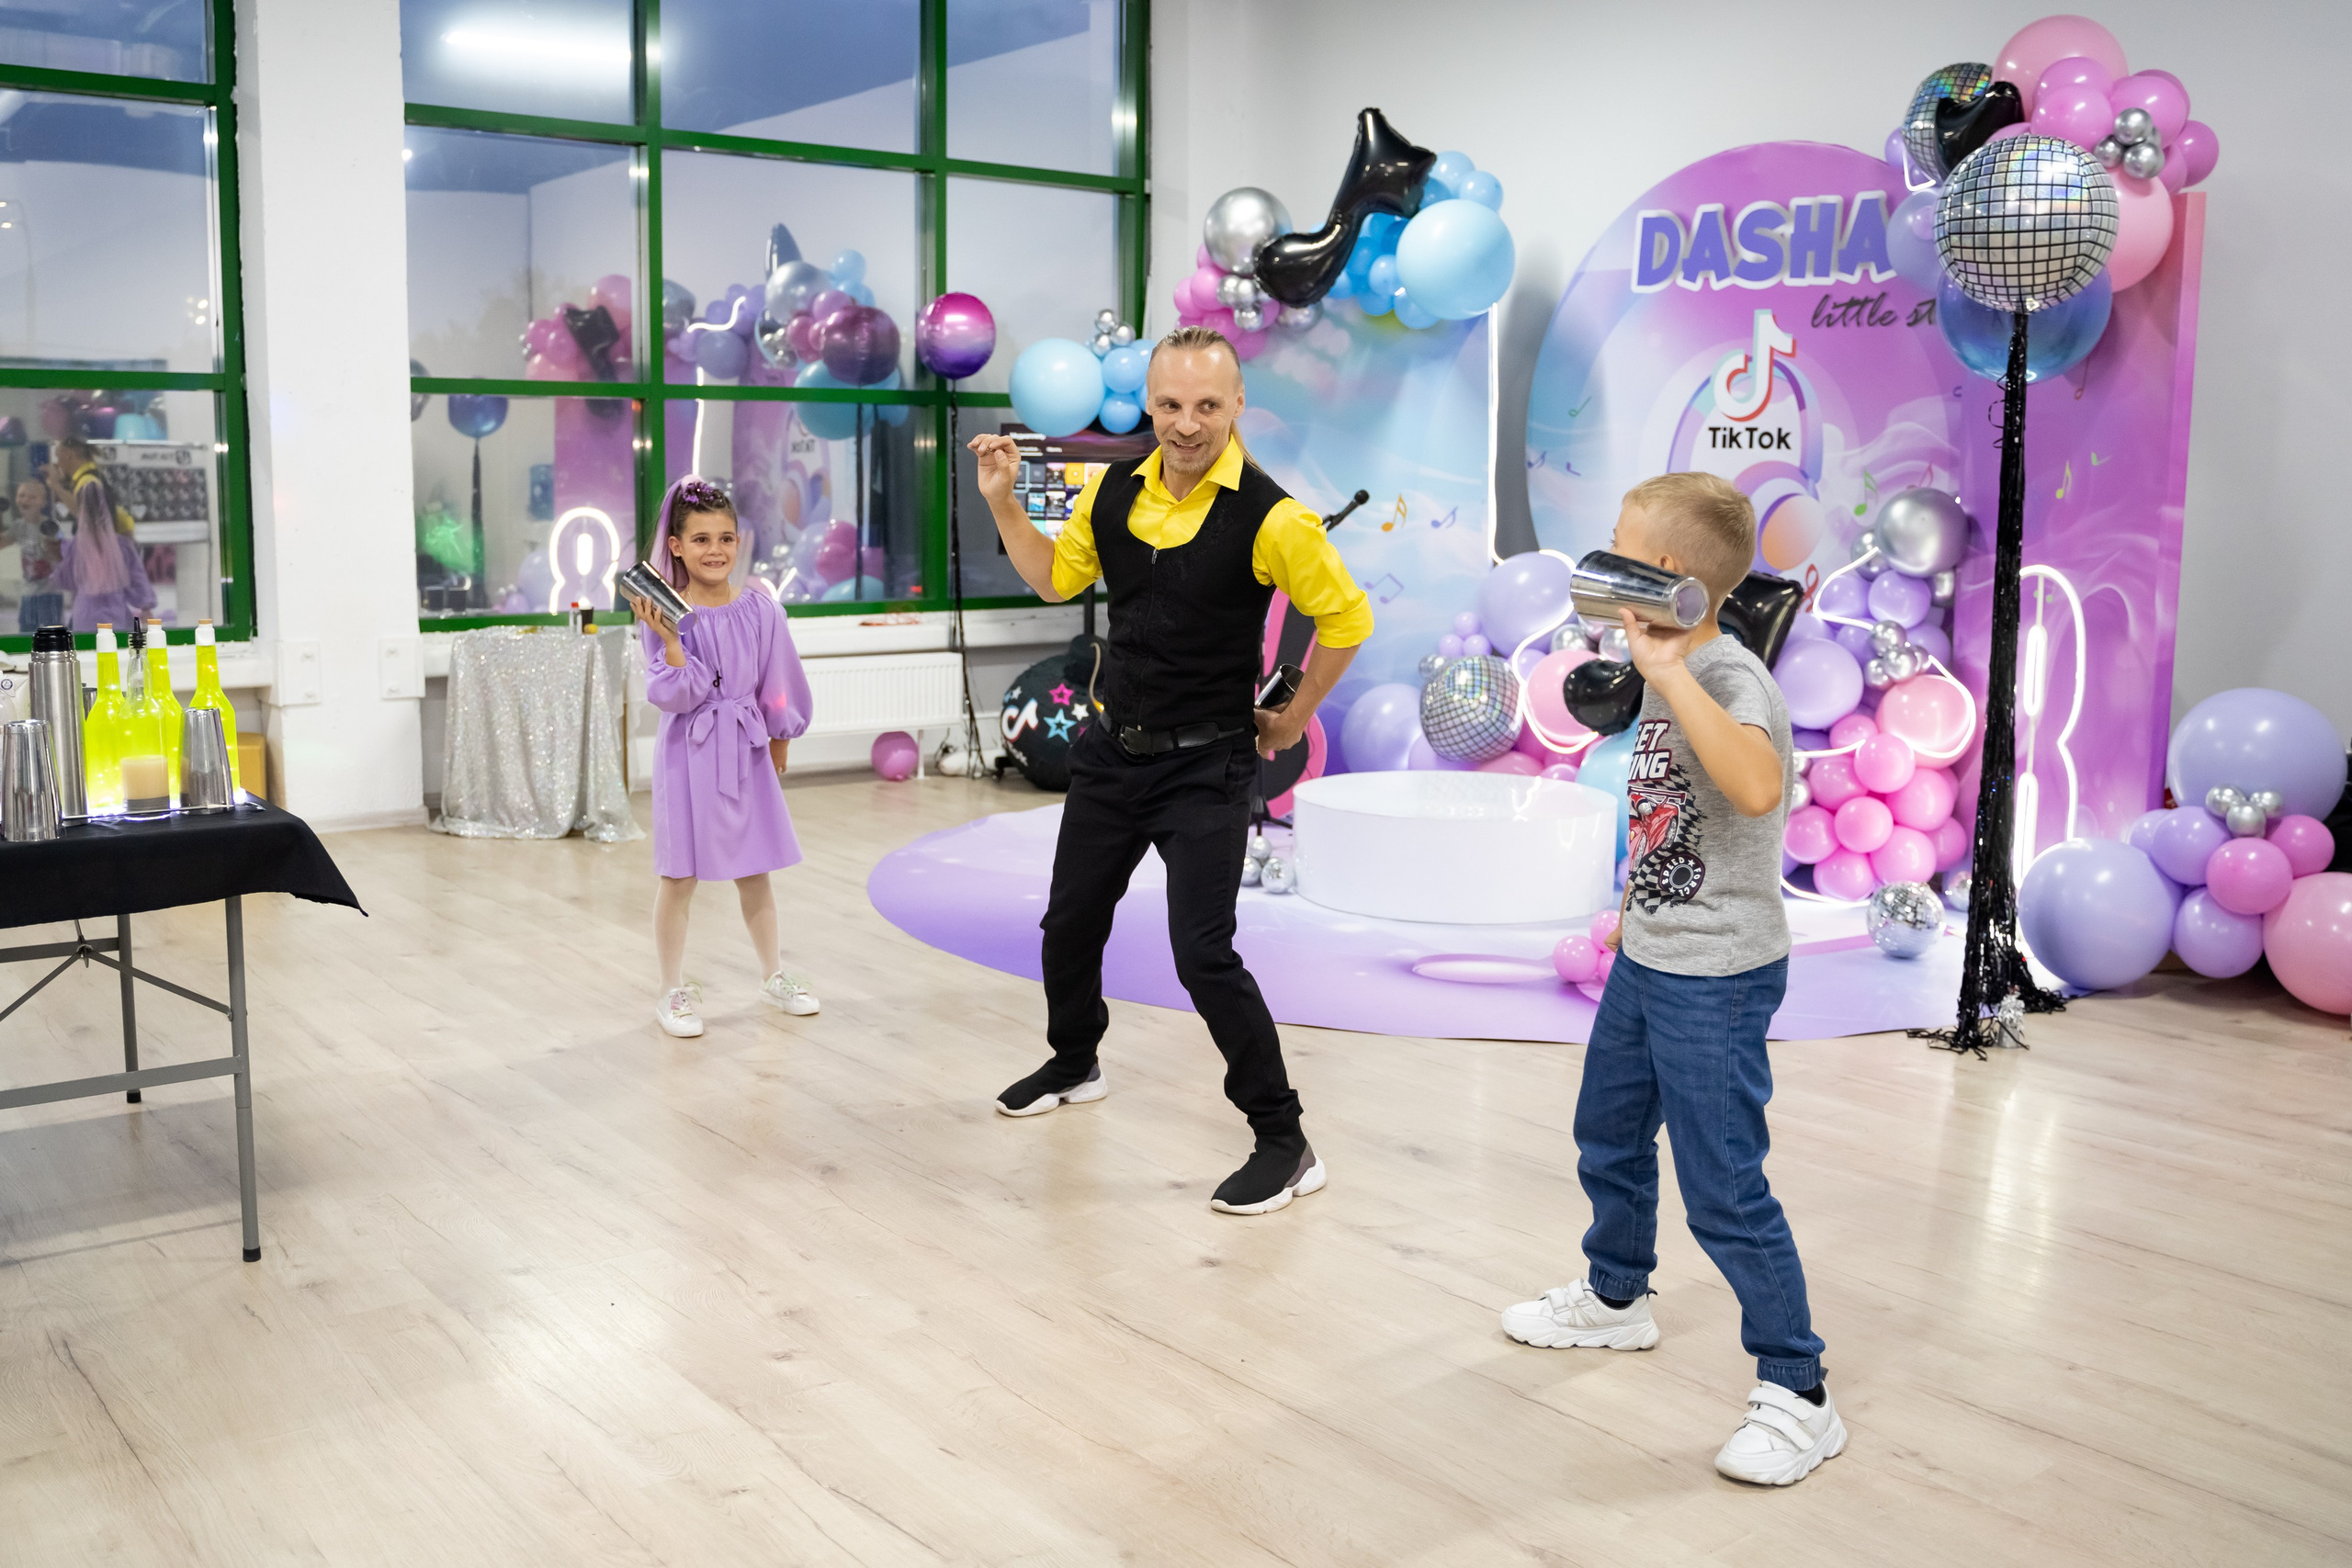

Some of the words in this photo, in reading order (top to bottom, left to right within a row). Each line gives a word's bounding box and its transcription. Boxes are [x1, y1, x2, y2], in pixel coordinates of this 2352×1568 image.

[1631, 191, 1896, 293] DASHA
[1811, 291, 1898, 328] little
[1906, 298, 1936, 327] st
[1708, 426, 1792, 450] TikTok
[1628, 750, 1671, 781] ING
[1661, 856, 1686, 885] SPEED
[1678, 866, 1702, 897] FORCE
